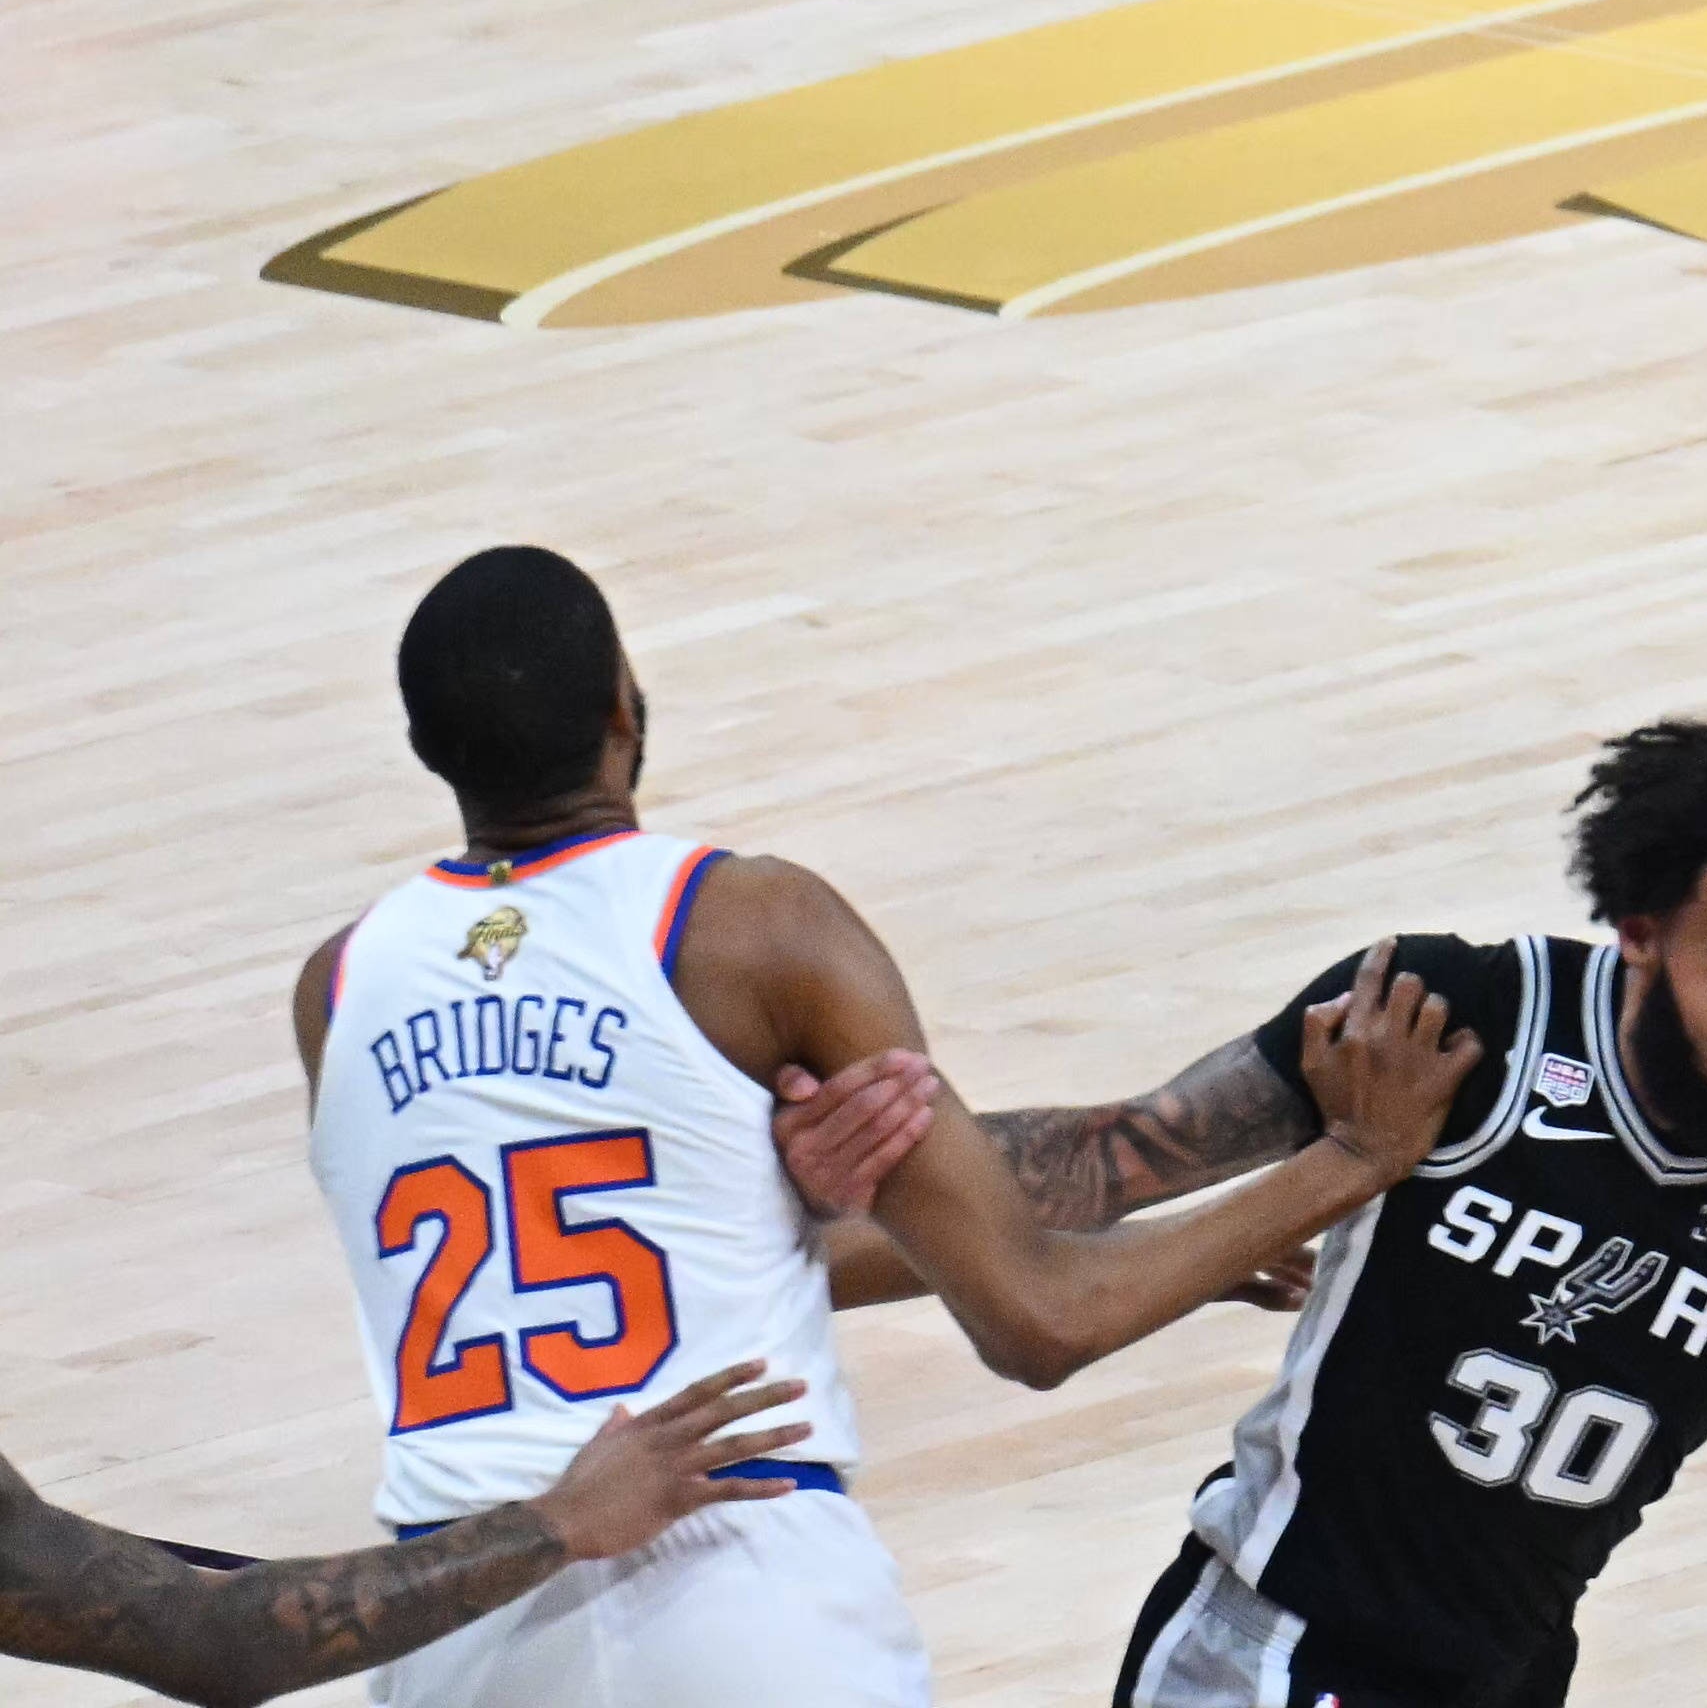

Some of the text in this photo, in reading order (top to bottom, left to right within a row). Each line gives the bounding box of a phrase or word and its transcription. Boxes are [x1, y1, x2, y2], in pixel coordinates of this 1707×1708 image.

[371, 995, 627, 1113] BRIDGES
[375, 1126, 680, 1437] 25
[1429, 1348, 1657, 1509] 30
